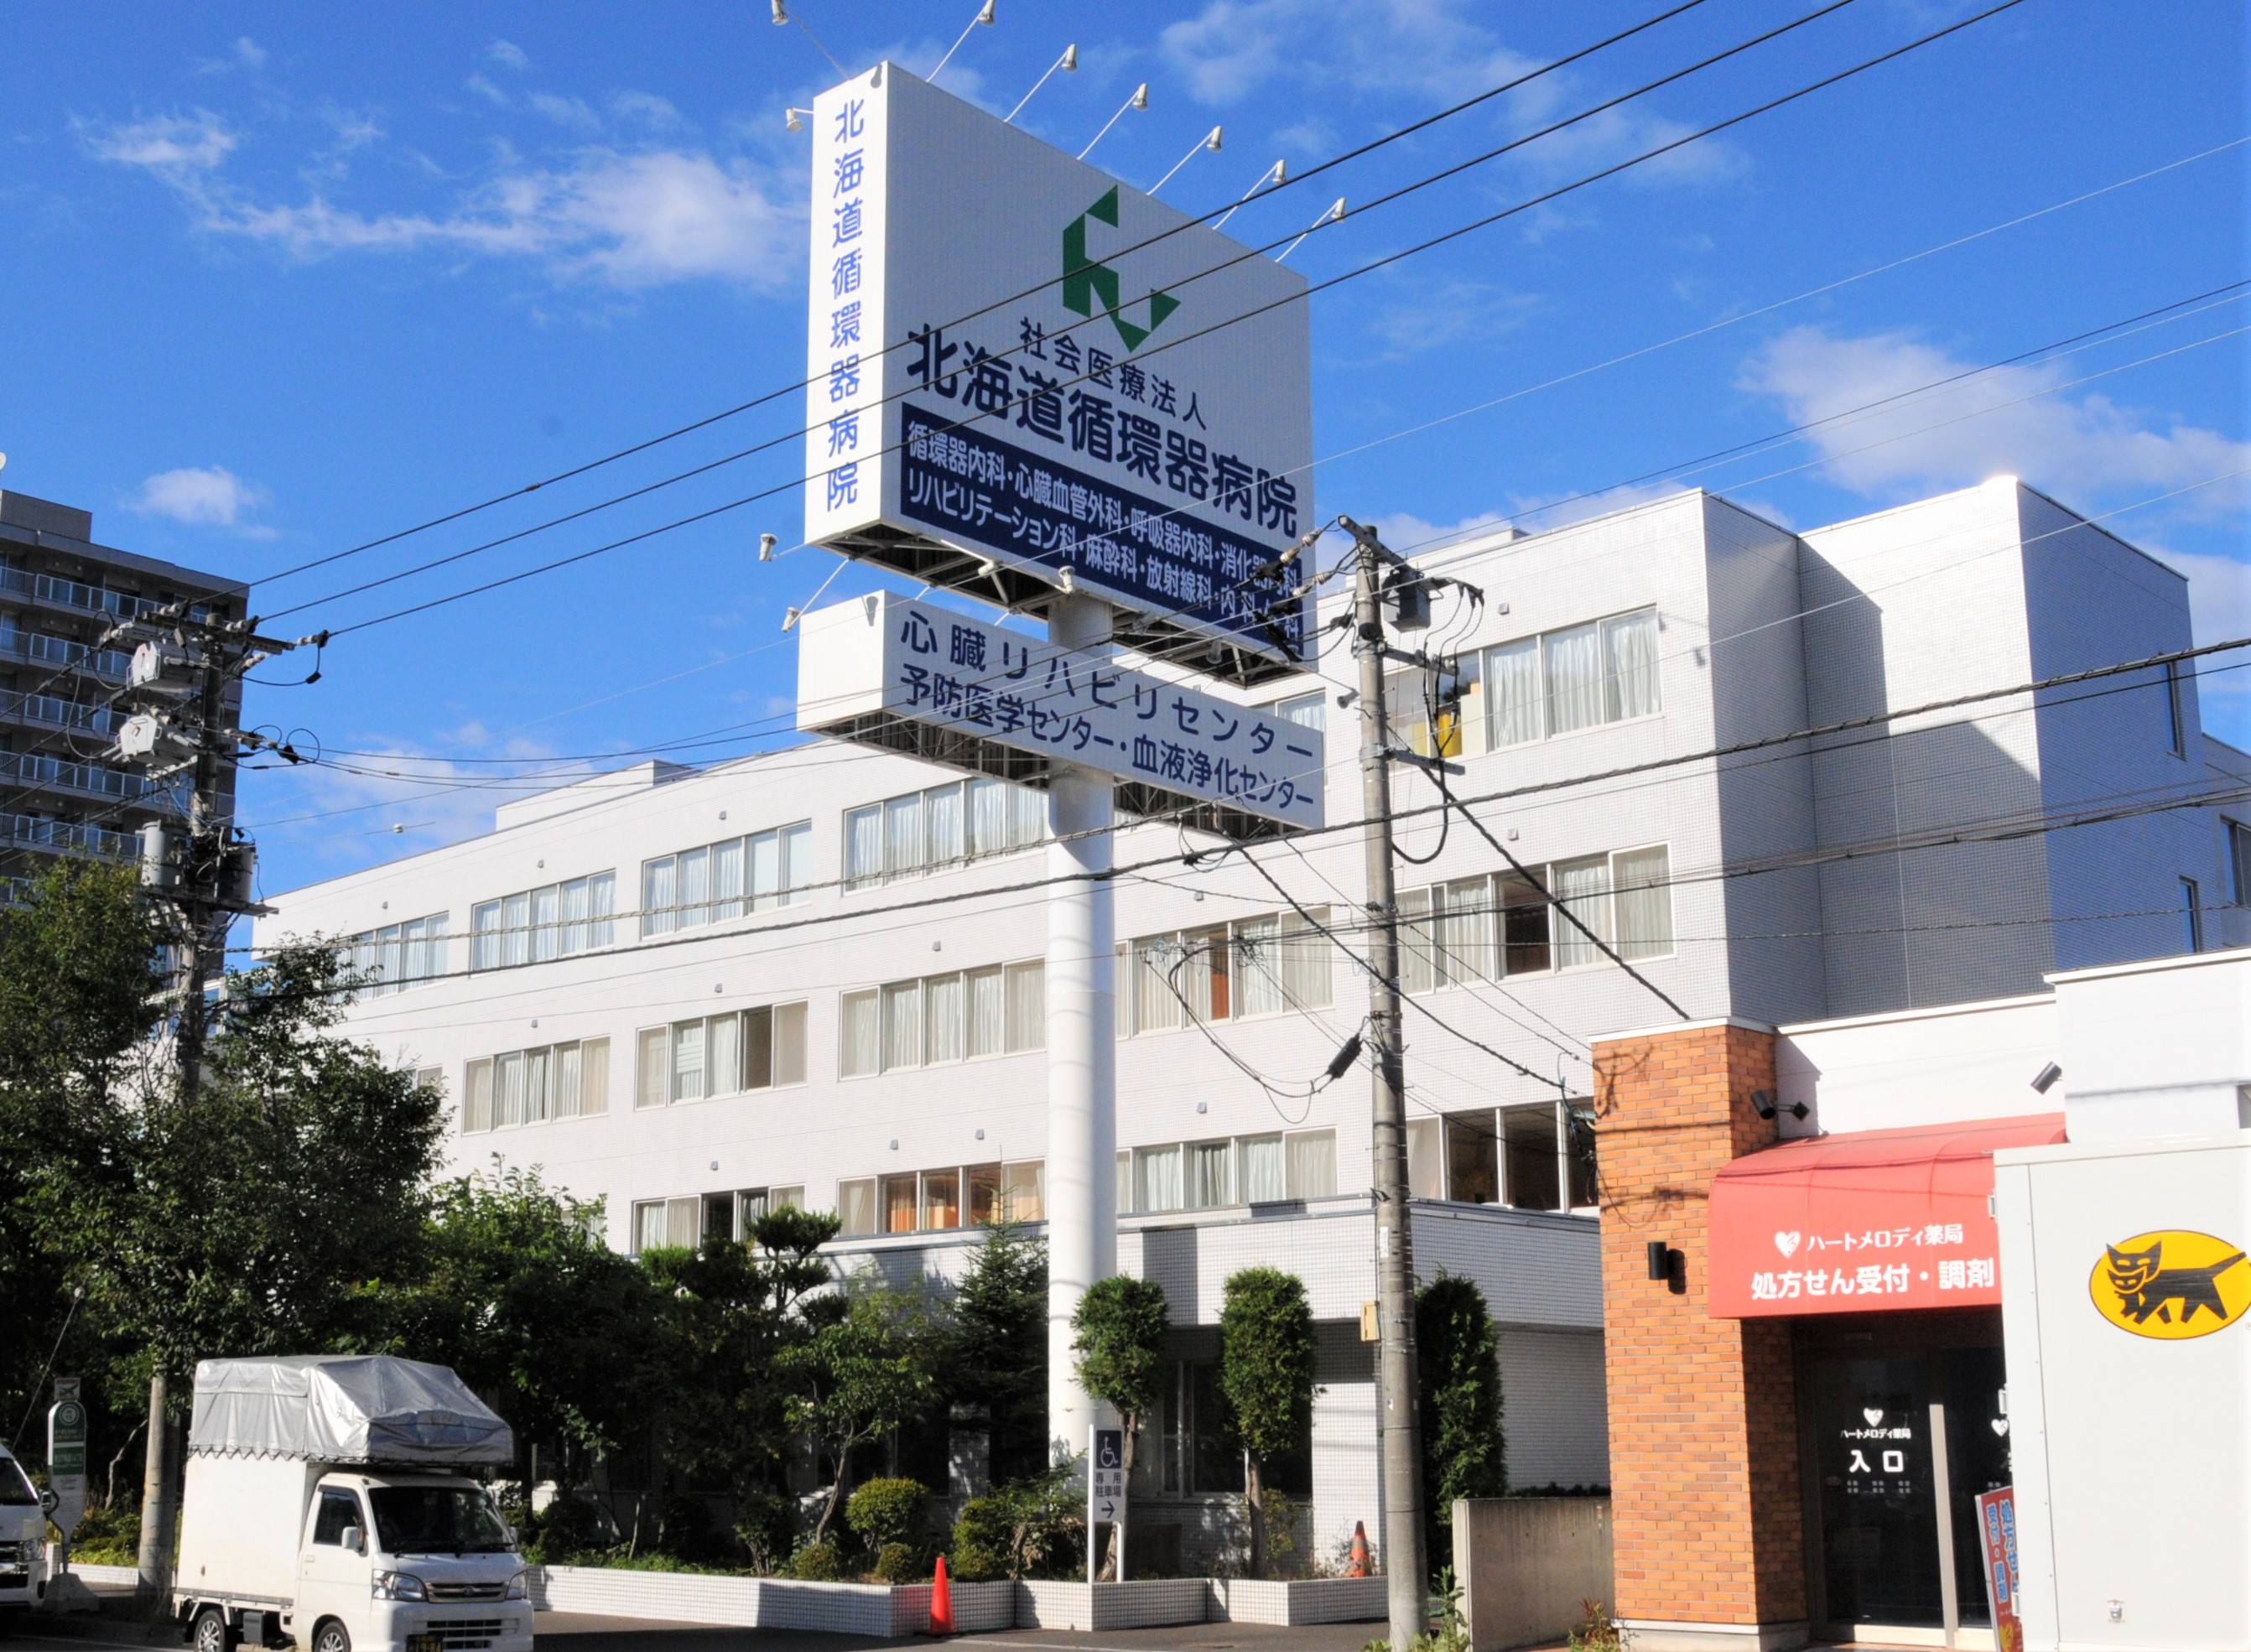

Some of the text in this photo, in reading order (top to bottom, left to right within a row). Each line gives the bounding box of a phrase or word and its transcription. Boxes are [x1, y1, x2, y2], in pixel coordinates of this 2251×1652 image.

[827, 98, 865, 512] 北海道循環器病院
[906, 324, 1297, 538] 北海道循環器病院
[1021, 316, 1207, 431] 社会医療法人
[900, 610, 1313, 757] 心臓リハビリセンター
[900, 662, 1314, 808] 予防医学センター・血液浄化センター
[1750, 1257, 1995, 1300] 処方せん受付・調剤
[1807, 1223, 1964, 1252] ハートメロディ薬局
[1848, 1449, 1904, 1473] 入口
